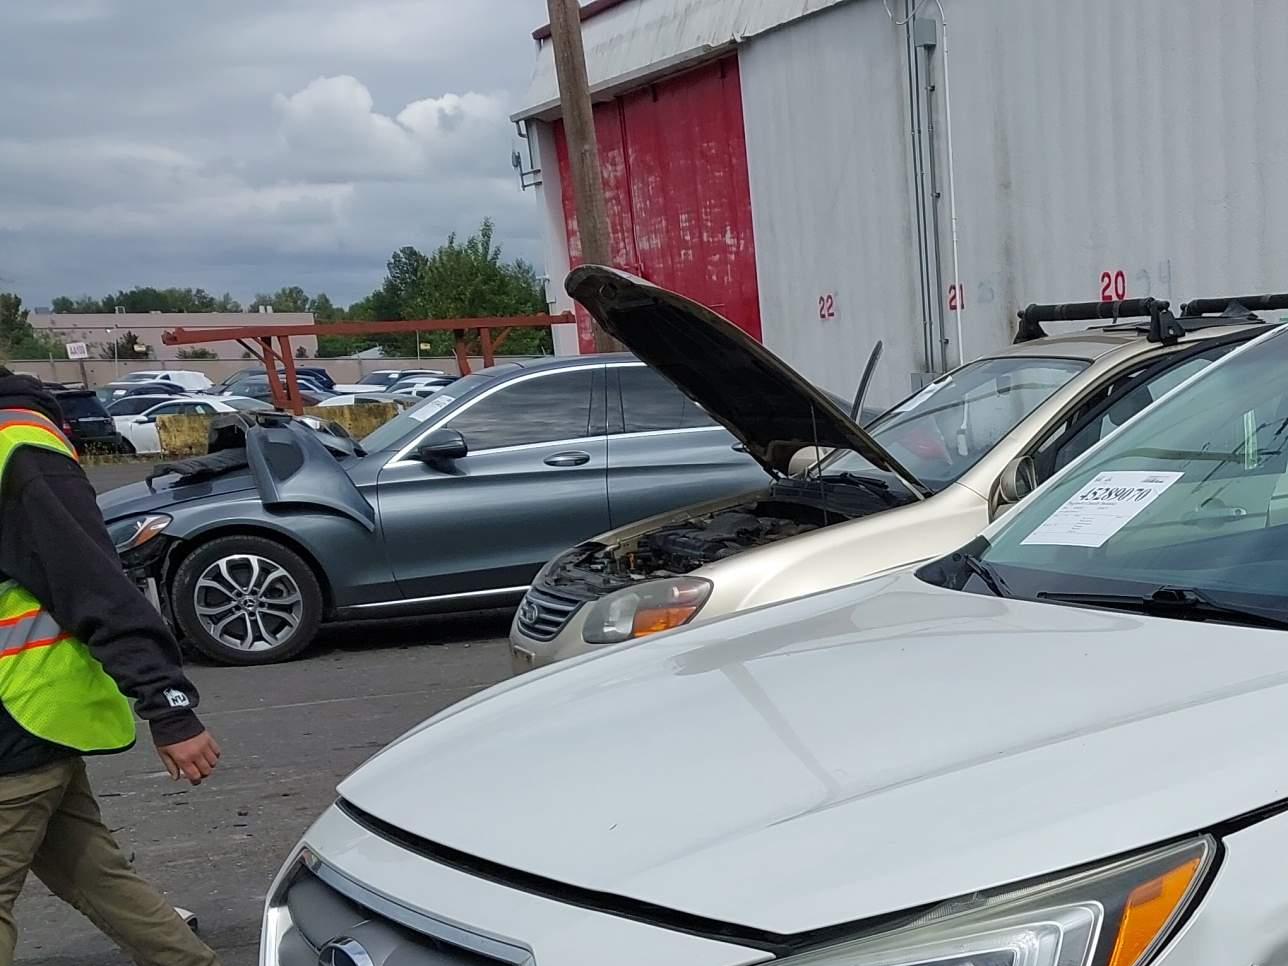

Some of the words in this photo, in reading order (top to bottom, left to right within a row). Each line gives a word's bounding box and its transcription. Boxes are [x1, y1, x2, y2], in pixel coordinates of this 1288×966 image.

[948, 284, 966, 311] 21
[1100, 270, 1127, 302] 20
[818, 295, 835, 319] 22
[1079, 487, 1152, 501] 45289070
